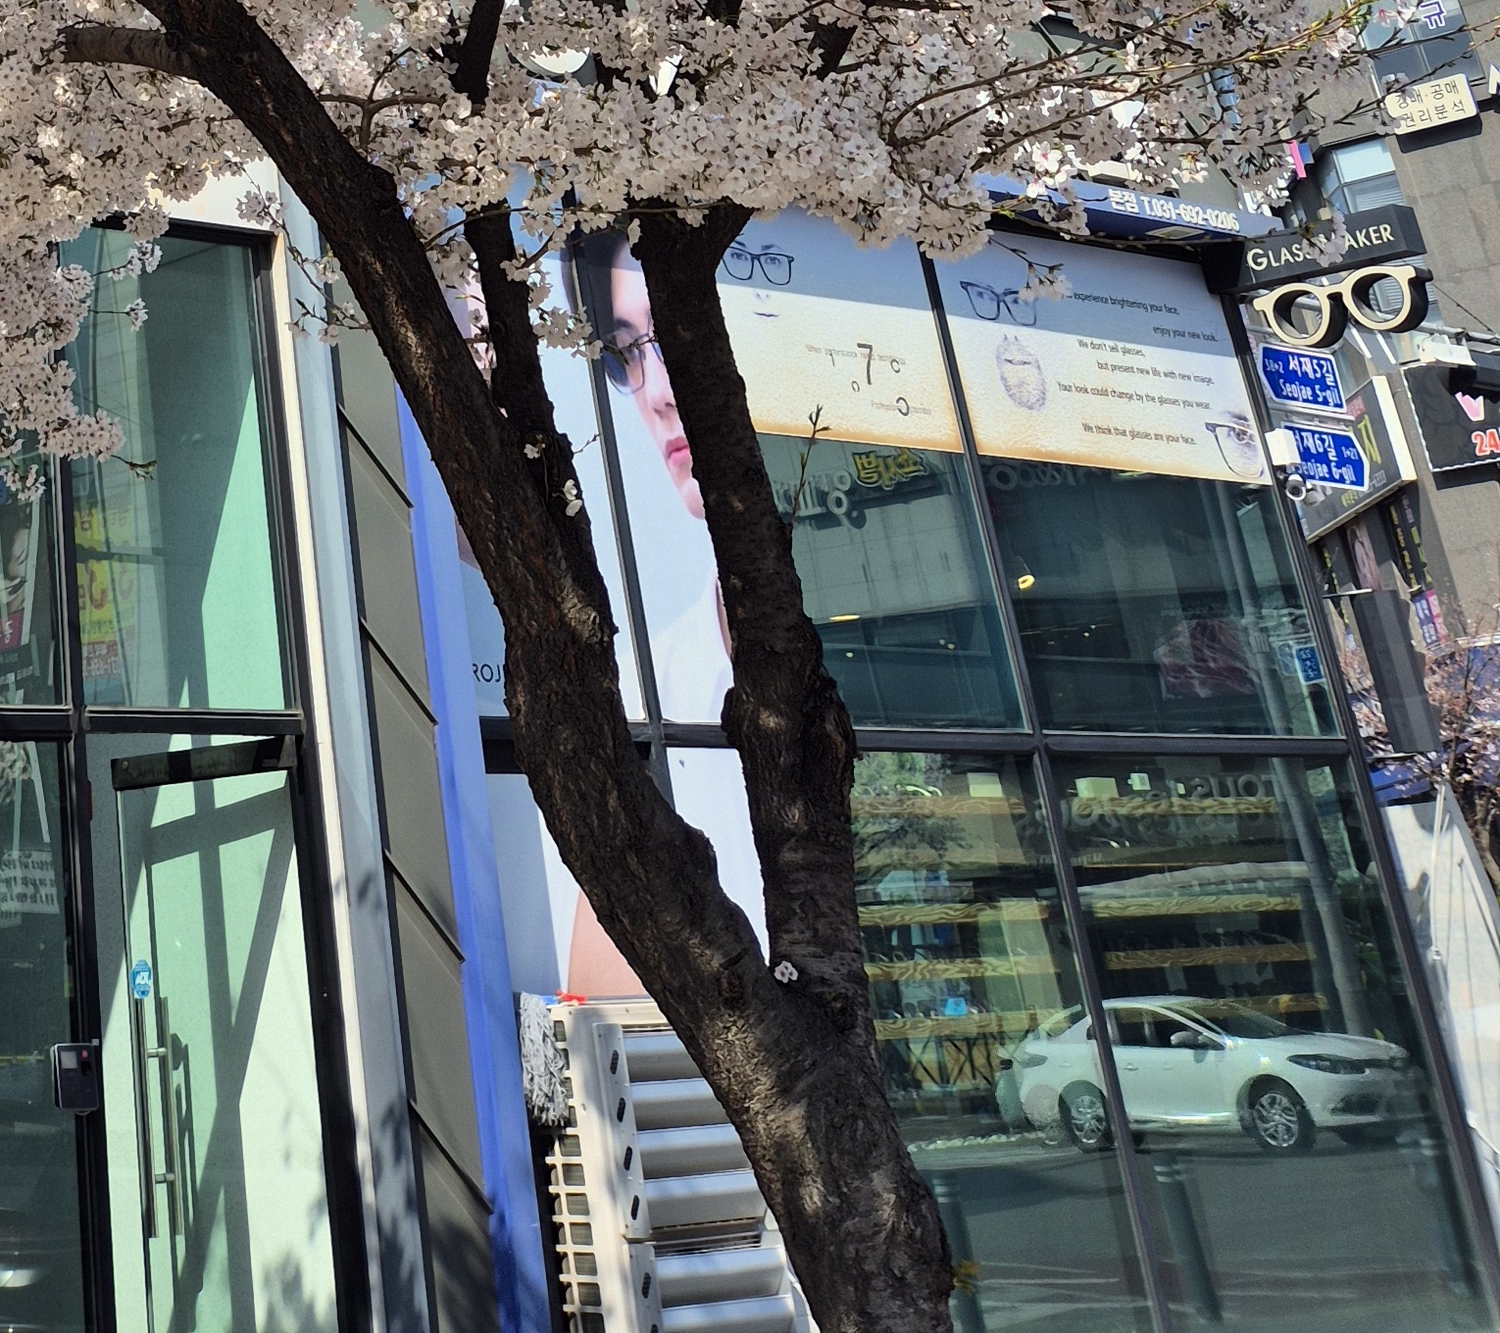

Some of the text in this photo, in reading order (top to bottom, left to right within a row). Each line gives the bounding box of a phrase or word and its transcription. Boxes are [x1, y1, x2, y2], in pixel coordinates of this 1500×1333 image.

[1108, 188, 1140, 214] 본점
[1140, 197, 1240, 233] T.031-692-0206
[1246, 223, 1395, 272] GLASAKER
[1153, 325, 1171, 338] enjoy
[1172, 328, 1186, 339] your
[1187, 330, 1201, 340] new
[1077, 339, 1089, 349] We
[1090, 340, 1108, 351] don't
[1108, 342, 1120, 353] sell
[1097, 360, 1110, 370] but
[1111, 363, 1136, 375] present
[1136, 366, 1150, 375] new
[1178, 371, 1192, 381] new
[1288, 354, 1336, 387] 서재5길
[1057, 381, 1073, 393] Your
[1073, 383, 1090, 394] look
[1110, 388, 1134, 401] change
[1135, 391, 1144, 403] by
[1145, 393, 1157, 403] the
[1157, 395, 1181, 407] glasses
[1181, 399, 1194, 409] you
[1279, 378, 1313, 402] Seojae
[1314, 384, 1342, 408] 5-gil
[1082, 422, 1094, 433] We
[1095, 423, 1112, 435] think
[1128, 428, 1152, 440] glasses
[1330, 461, 1357, 485] 6-gil
